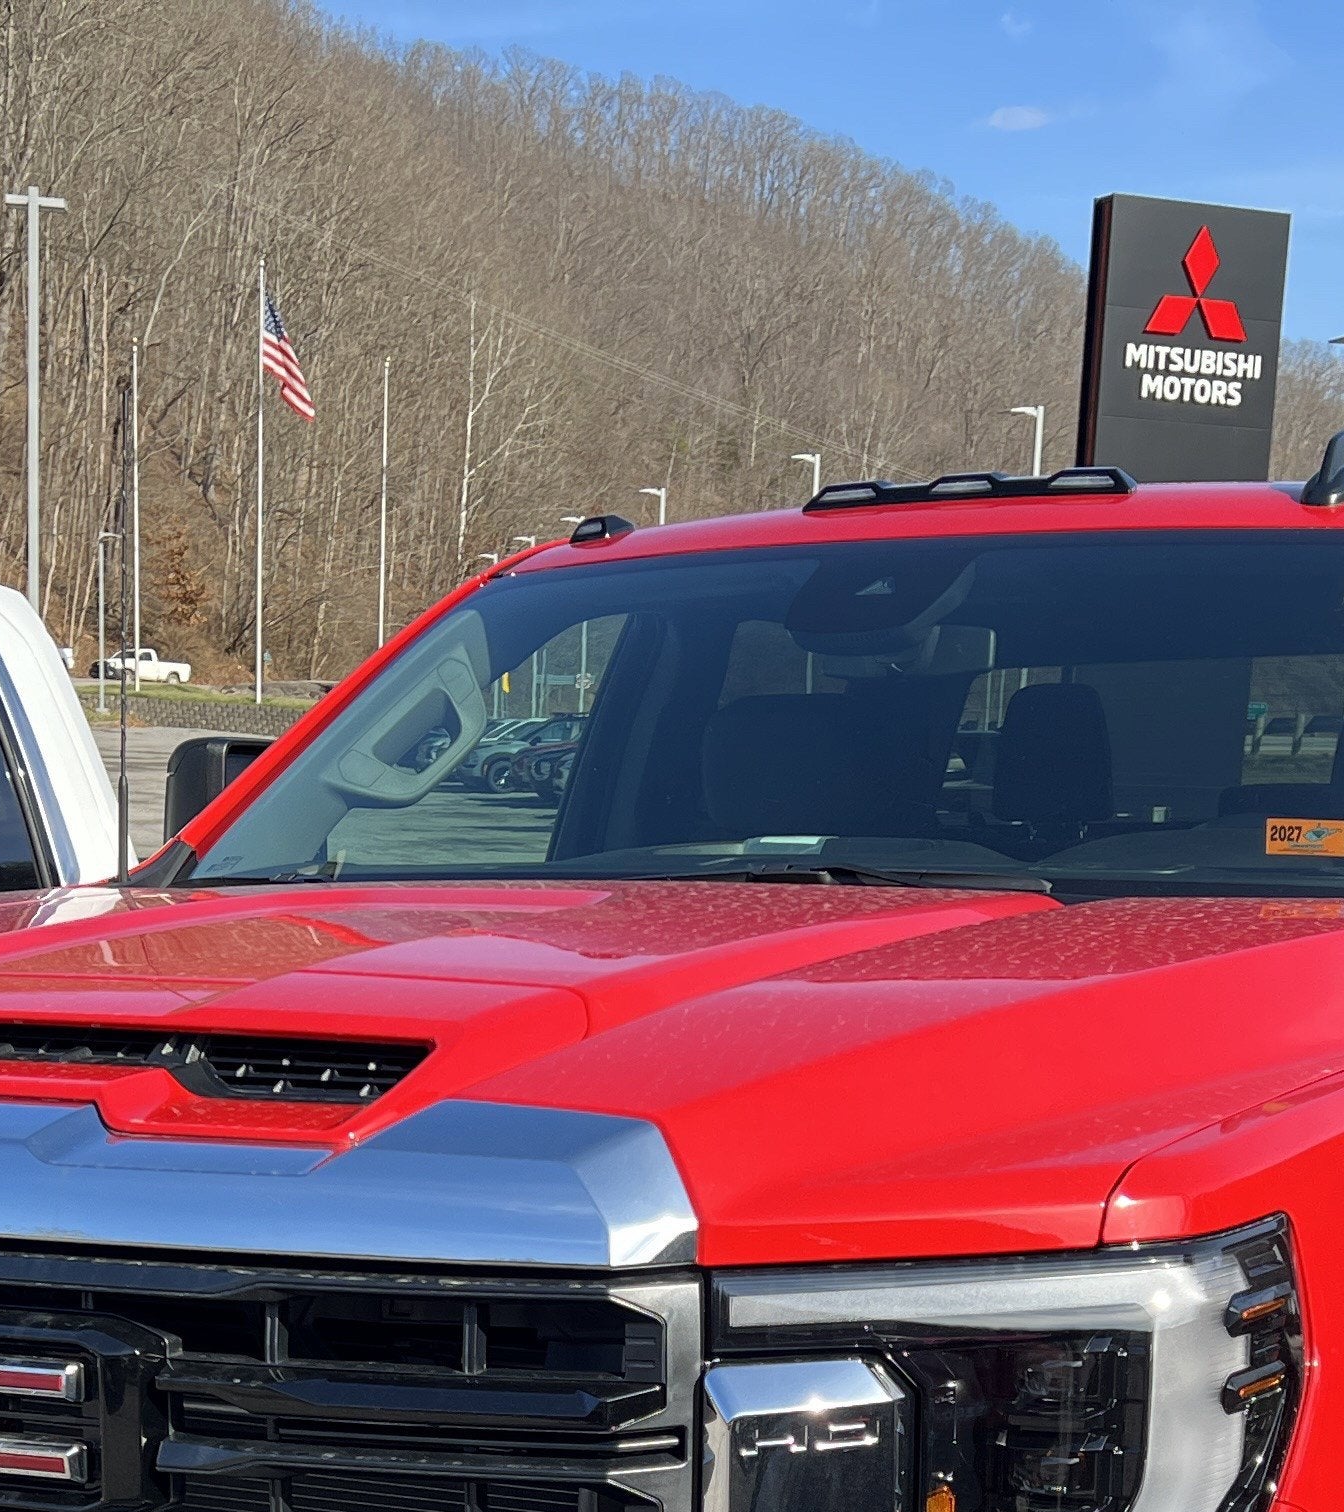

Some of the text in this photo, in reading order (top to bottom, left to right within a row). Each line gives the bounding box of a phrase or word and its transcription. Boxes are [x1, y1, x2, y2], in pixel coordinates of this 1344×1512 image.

[1124, 342, 1262, 380] MITSUBISHI
[1140, 373, 1242, 406] MOTORS
[1270, 825, 1303, 842] 2027
